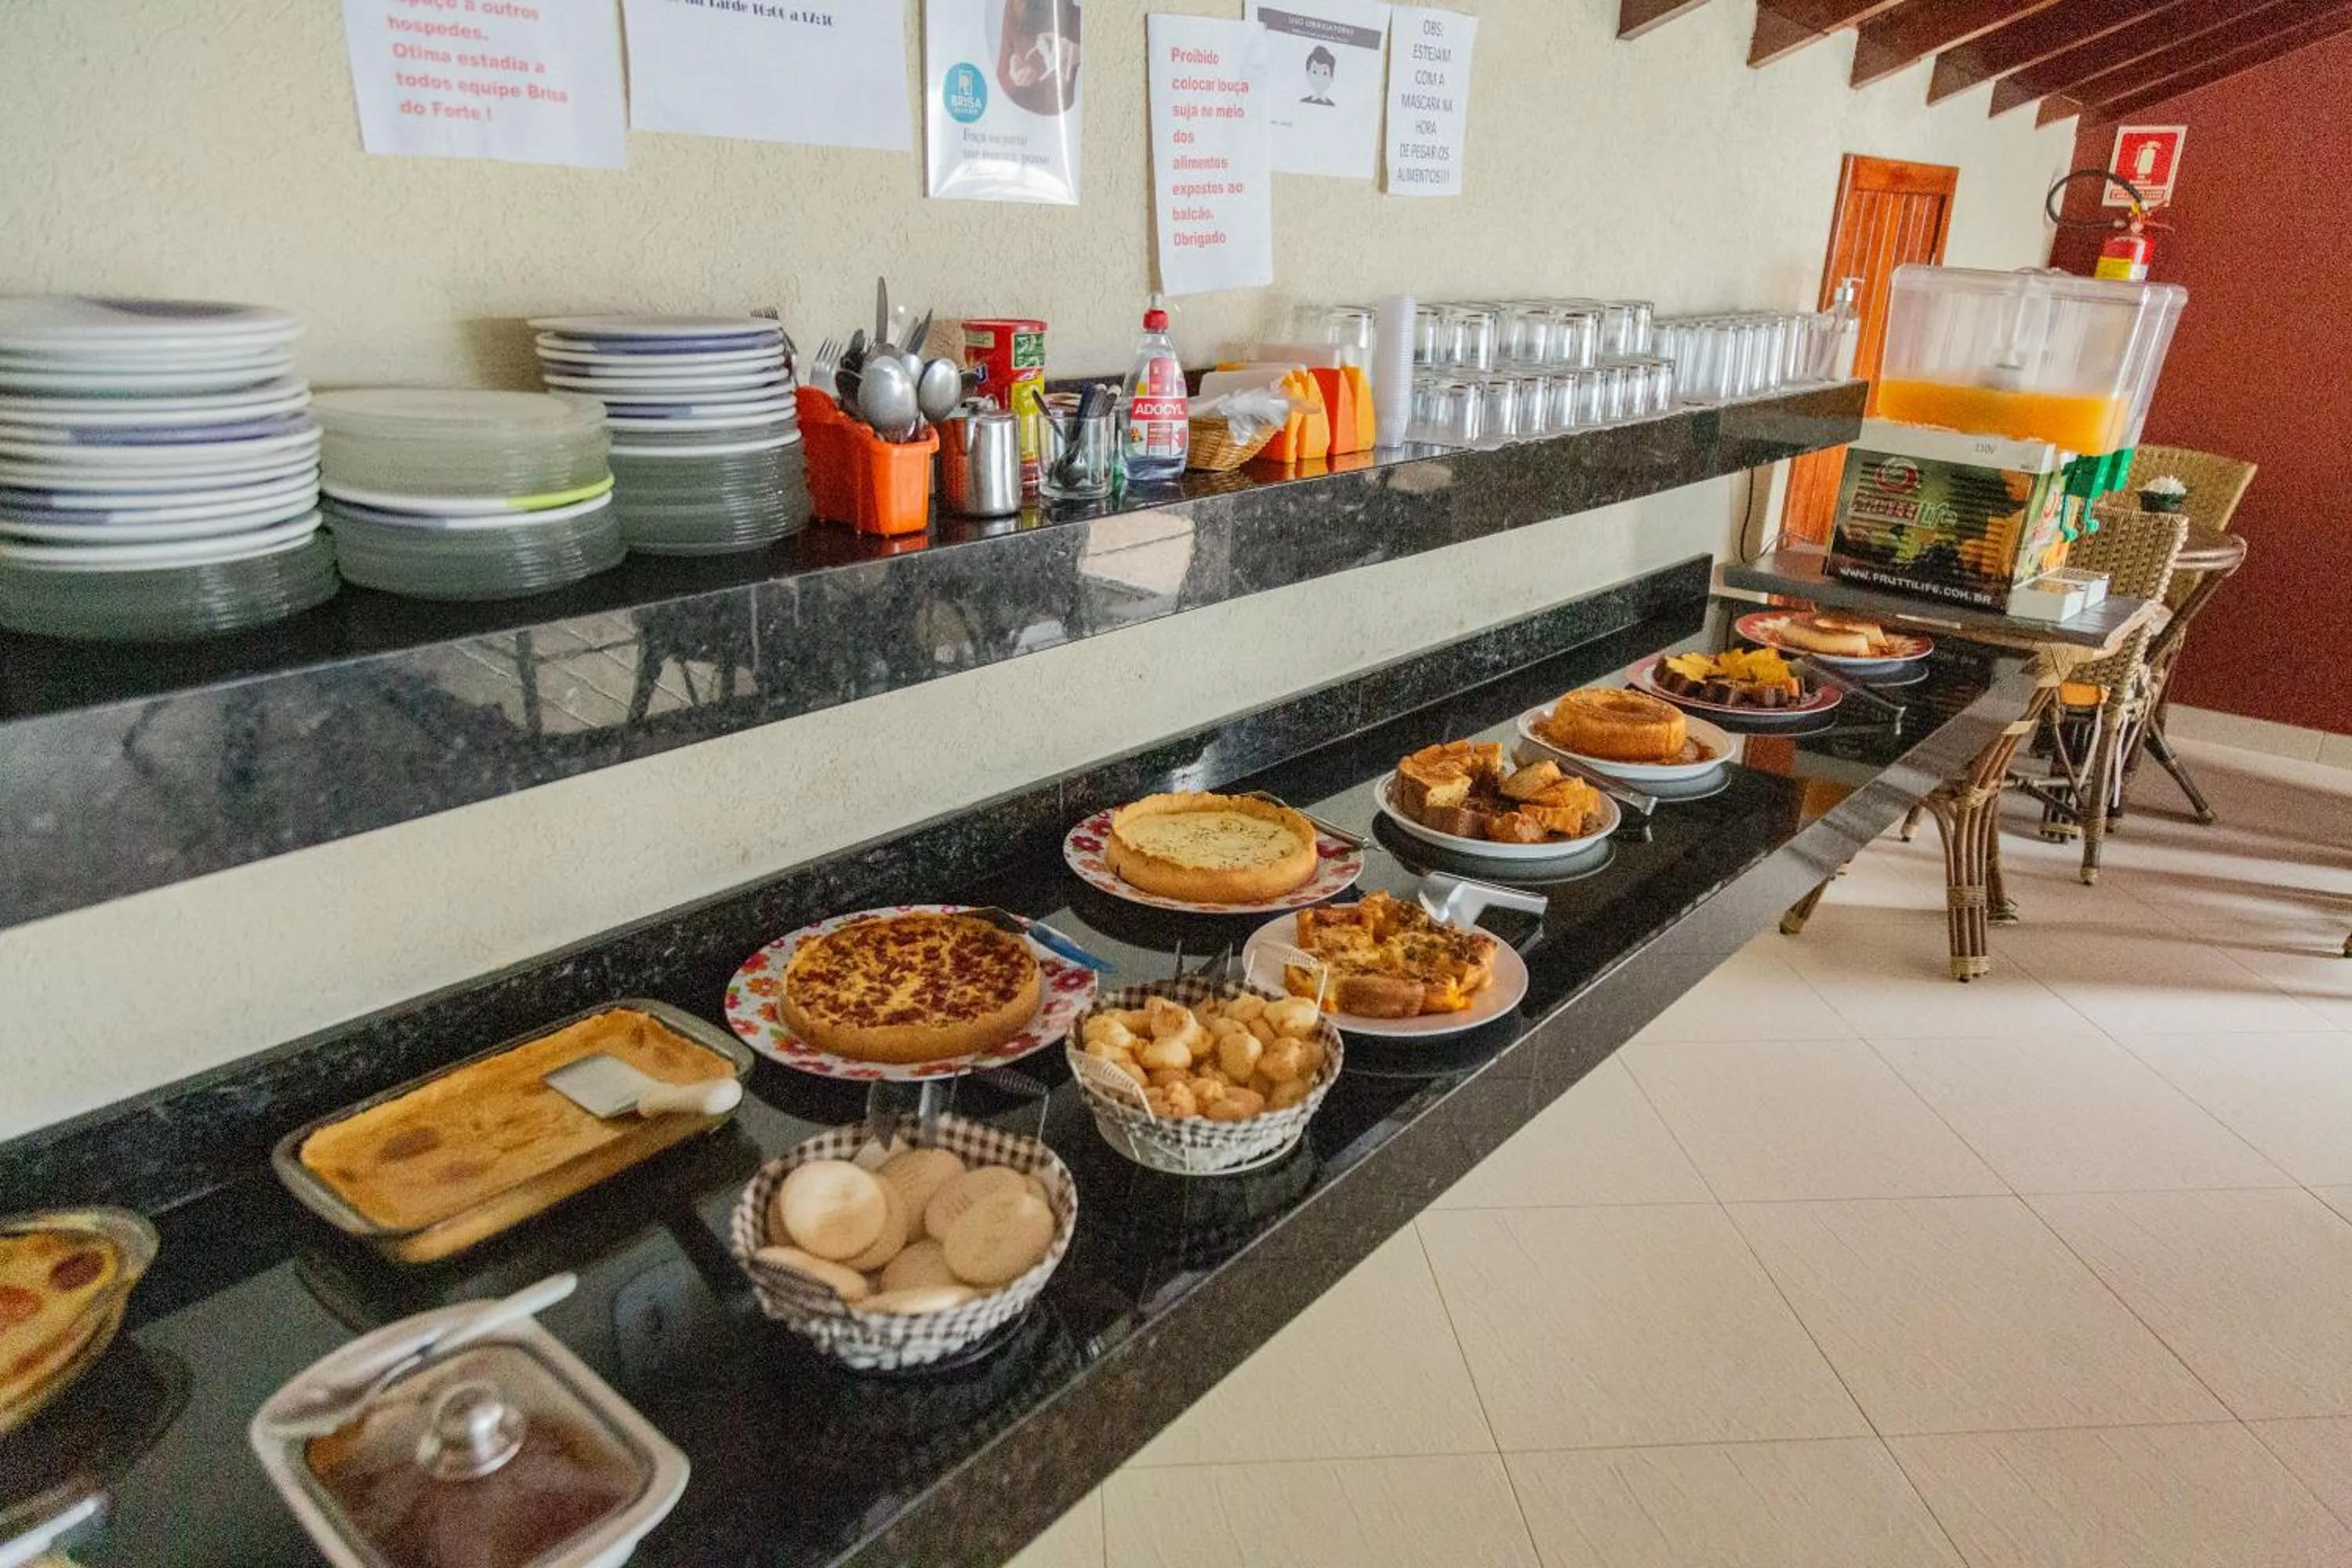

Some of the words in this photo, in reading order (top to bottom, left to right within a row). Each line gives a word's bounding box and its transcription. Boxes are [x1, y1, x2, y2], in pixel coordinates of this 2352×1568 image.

[481, 2, 539, 20] outros
[387, 14, 489, 41] hospedes.
[458, 52, 528, 73] estadia
[534, 63, 546, 74] a
[1171, 47, 1219, 65] Proibido
[1172, 76, 1214, 93] colocar
[1218, 78, 1249, 96] louça
[1415, 69, 1436, 86] COM
[395, 71, 453, 91] todos
[458, 80, 521, 100] equipe
[527, 82, 568, 103] Brisa
[400, 100, 426, 115] do
[431, 101, 481, 120] Forte
[1172, 105, 1199, 121] suja
[1200, 107, 1214, 118] no
[1216, 103, 1245, 119] meio
[1415, 118, 1437, 136] HORA
[1173, 130, 1194, 144] dos
[1437, 144, 1450, 161] OS
[1173, 156, 1229, 170] alimentos
[1173, 182, 1224, 198] expostos
[1228, 181, 1243, 194] ao
[1173, 206, 1214, 221] balcão.
[1174, 231, 1227, 248] Obrigado
[1134, 403, 1185, 416] ADOCYL
